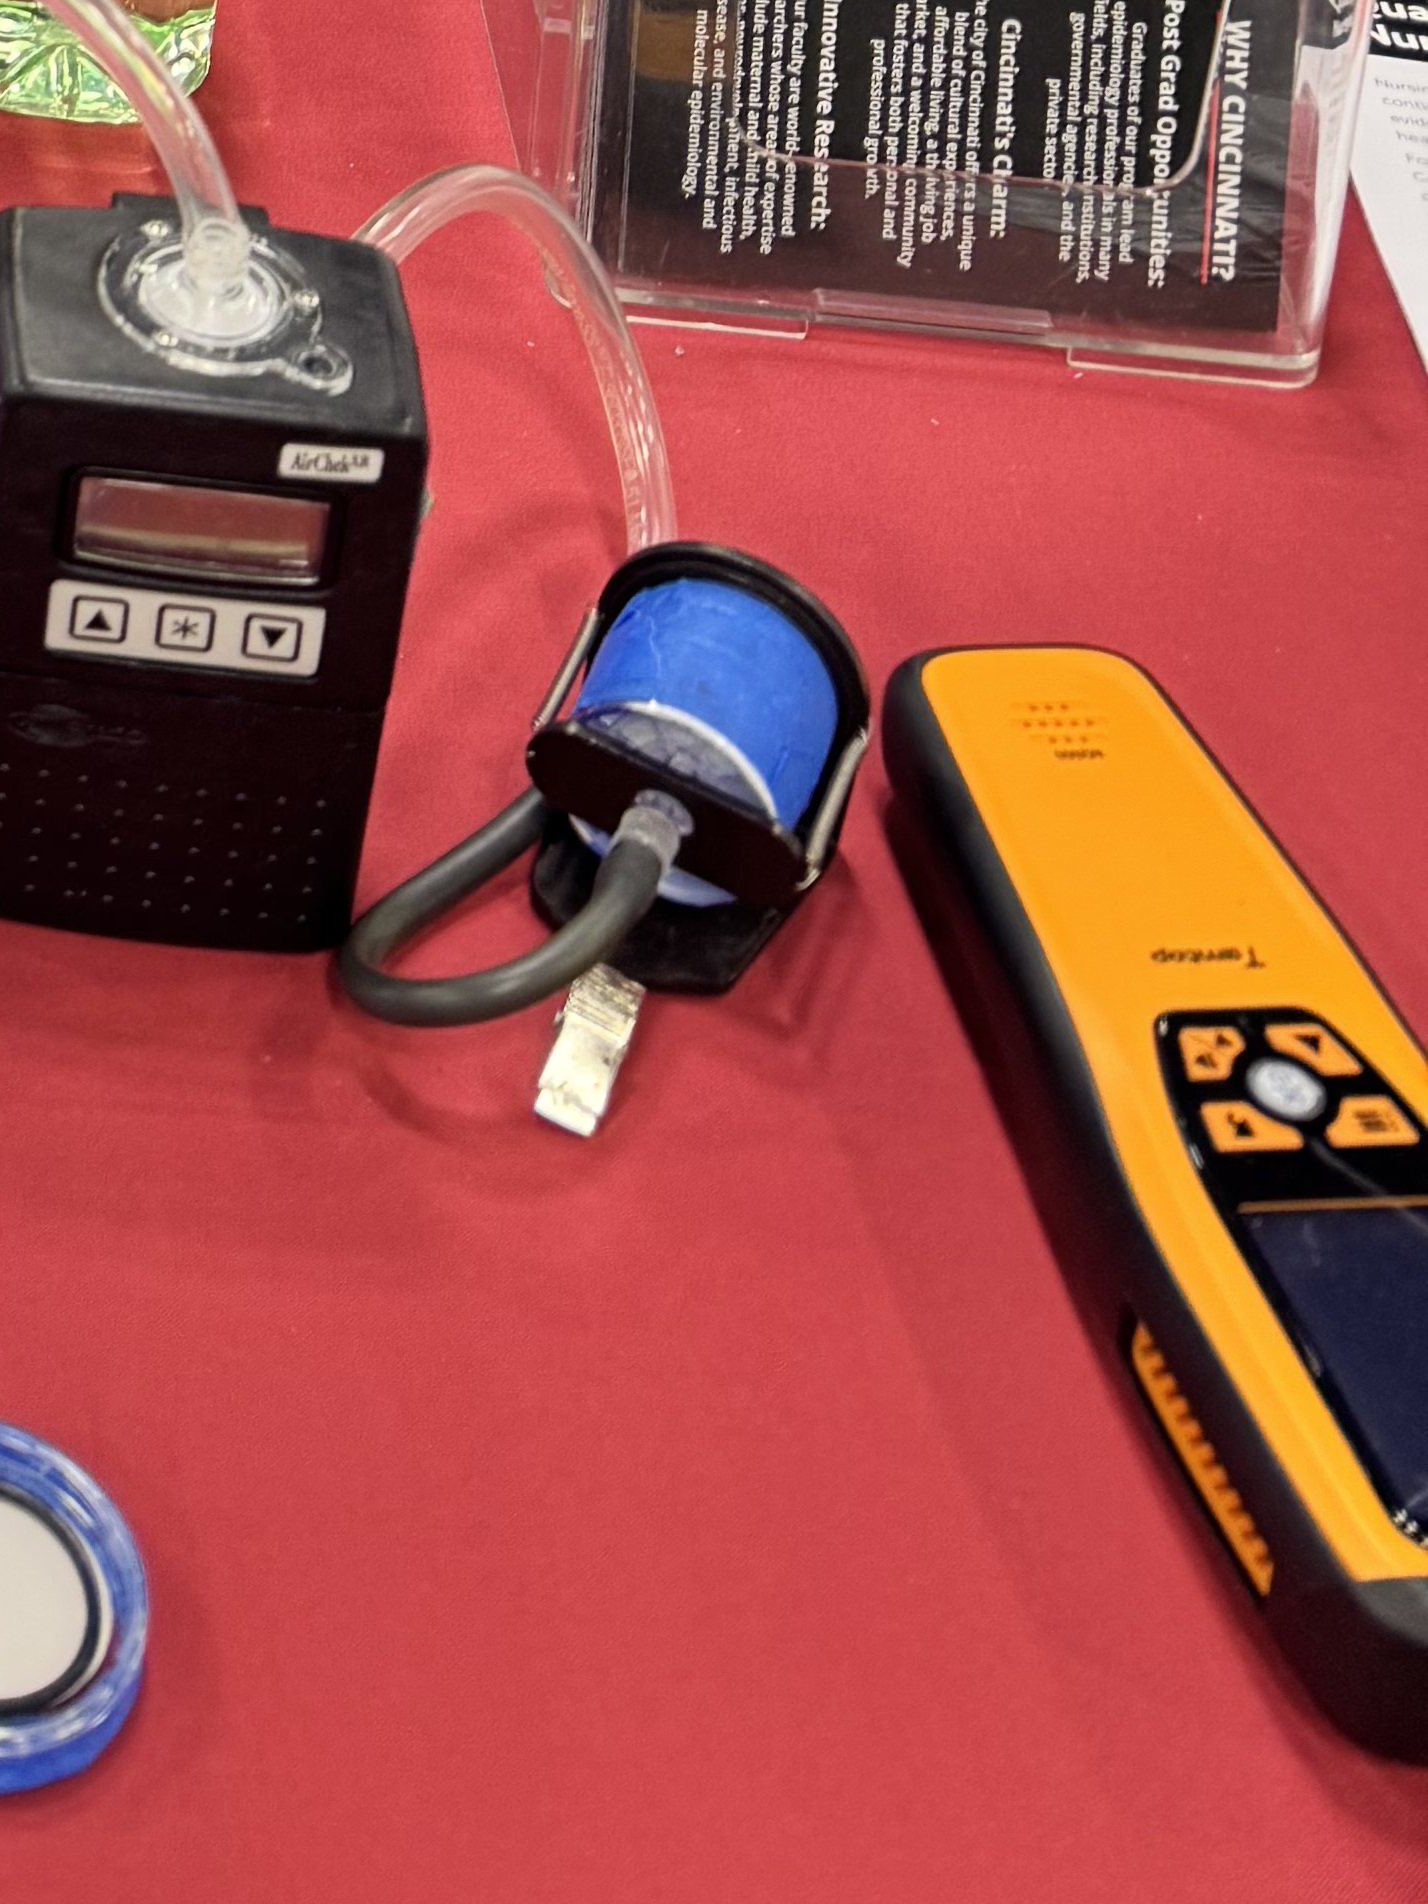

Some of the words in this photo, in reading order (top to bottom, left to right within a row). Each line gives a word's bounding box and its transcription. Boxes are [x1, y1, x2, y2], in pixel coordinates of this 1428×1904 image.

[1162, 0, 1185, 50] Post
[1223, 20, 1251, 89] WHY
[992, 19, 1021, 150] Cincinnati's
[1157, 55, 1181, 110] Grad
[810, 119, 838, 230] Research:
[1210, 96, 1247, 281] CINCINNATI?
